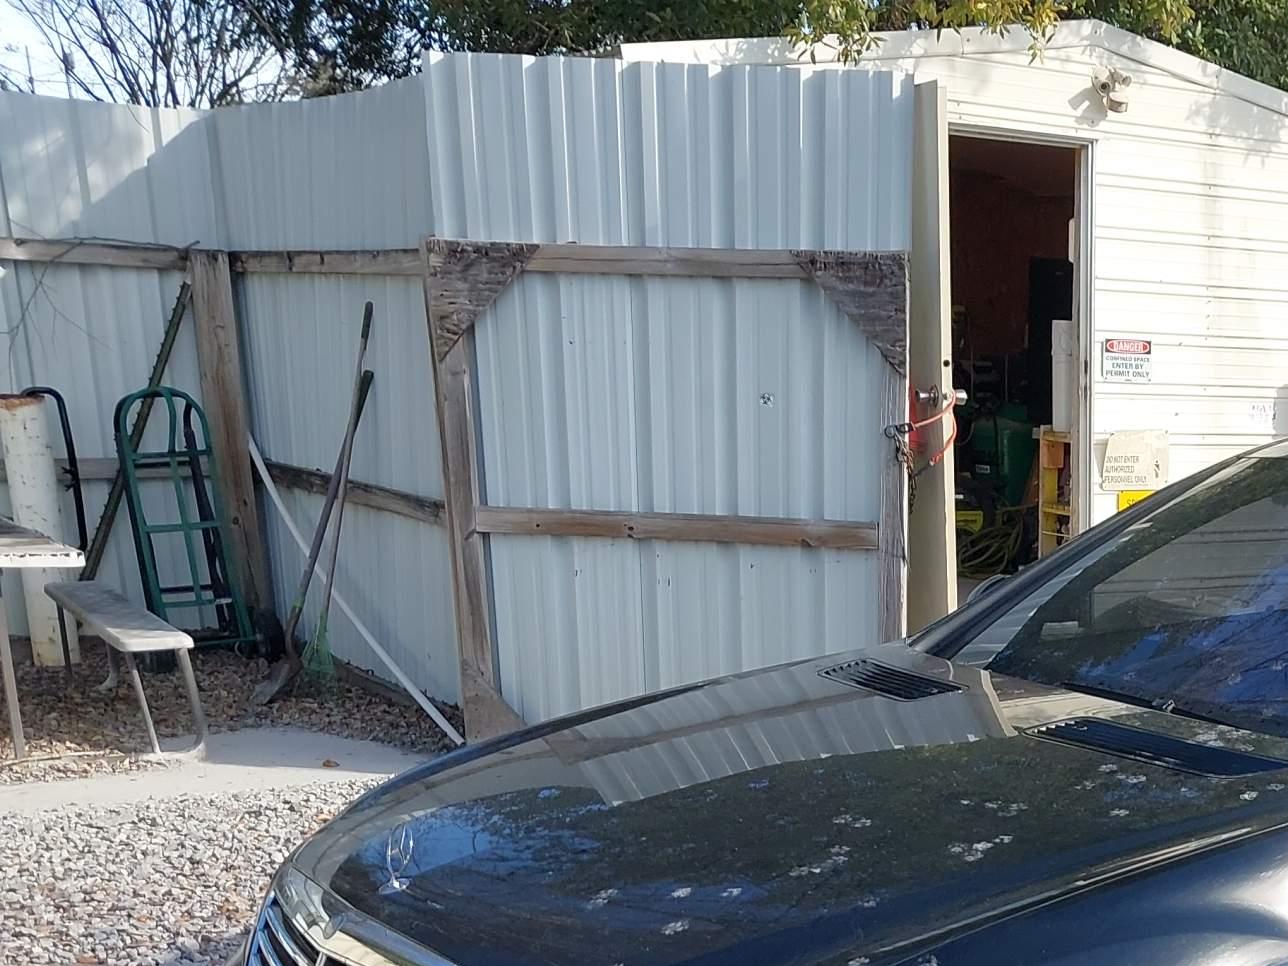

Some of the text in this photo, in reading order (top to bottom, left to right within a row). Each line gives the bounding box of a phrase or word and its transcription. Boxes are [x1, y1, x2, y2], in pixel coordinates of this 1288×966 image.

[1113, 341, 1143, 352] DANGER
[1132, 370, 1149, 378] ONLY
[1105, 465, 1134, 473] AUTHORIZED
[1104, 475, 1133, 483] PERSONNEL
